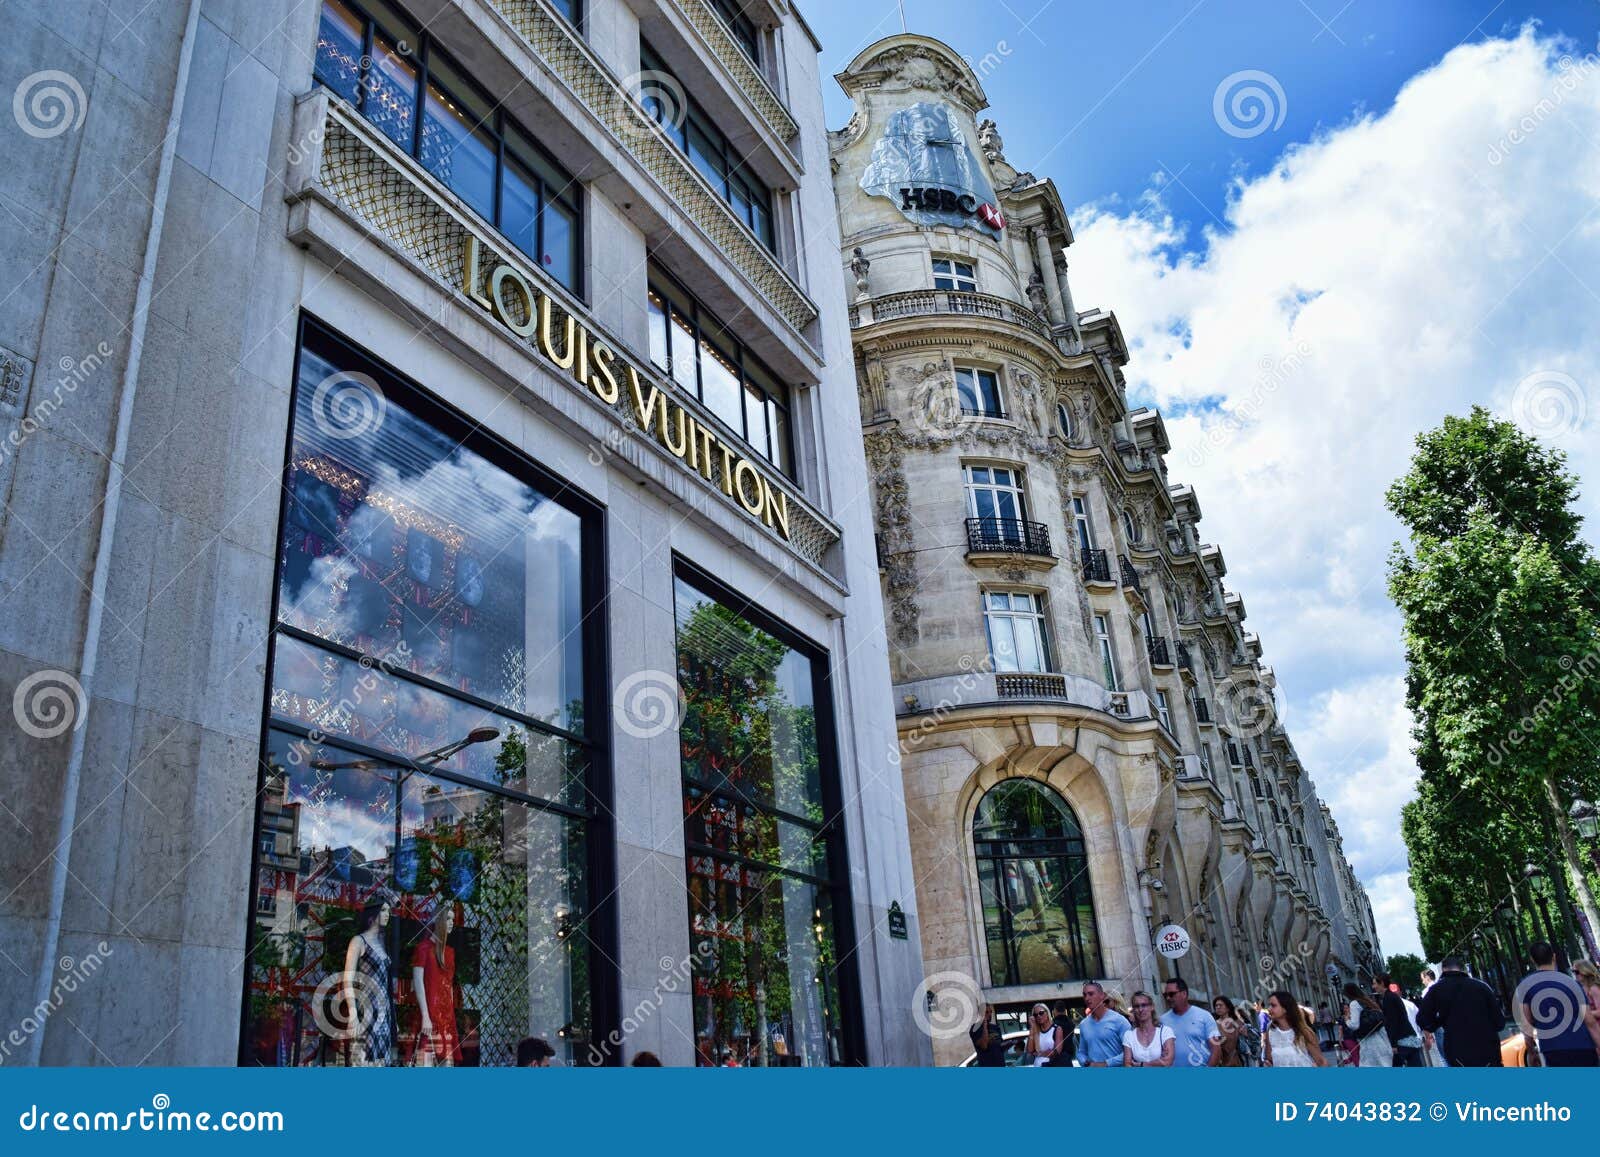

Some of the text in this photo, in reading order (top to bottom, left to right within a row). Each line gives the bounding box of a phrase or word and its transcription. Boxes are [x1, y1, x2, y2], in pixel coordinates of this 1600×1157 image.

[899, 187, 976, 218] HSBC
[463, 235, 790, 542] LOUIS VUITTON
[1160, 940, 1188, 953] HSBC
